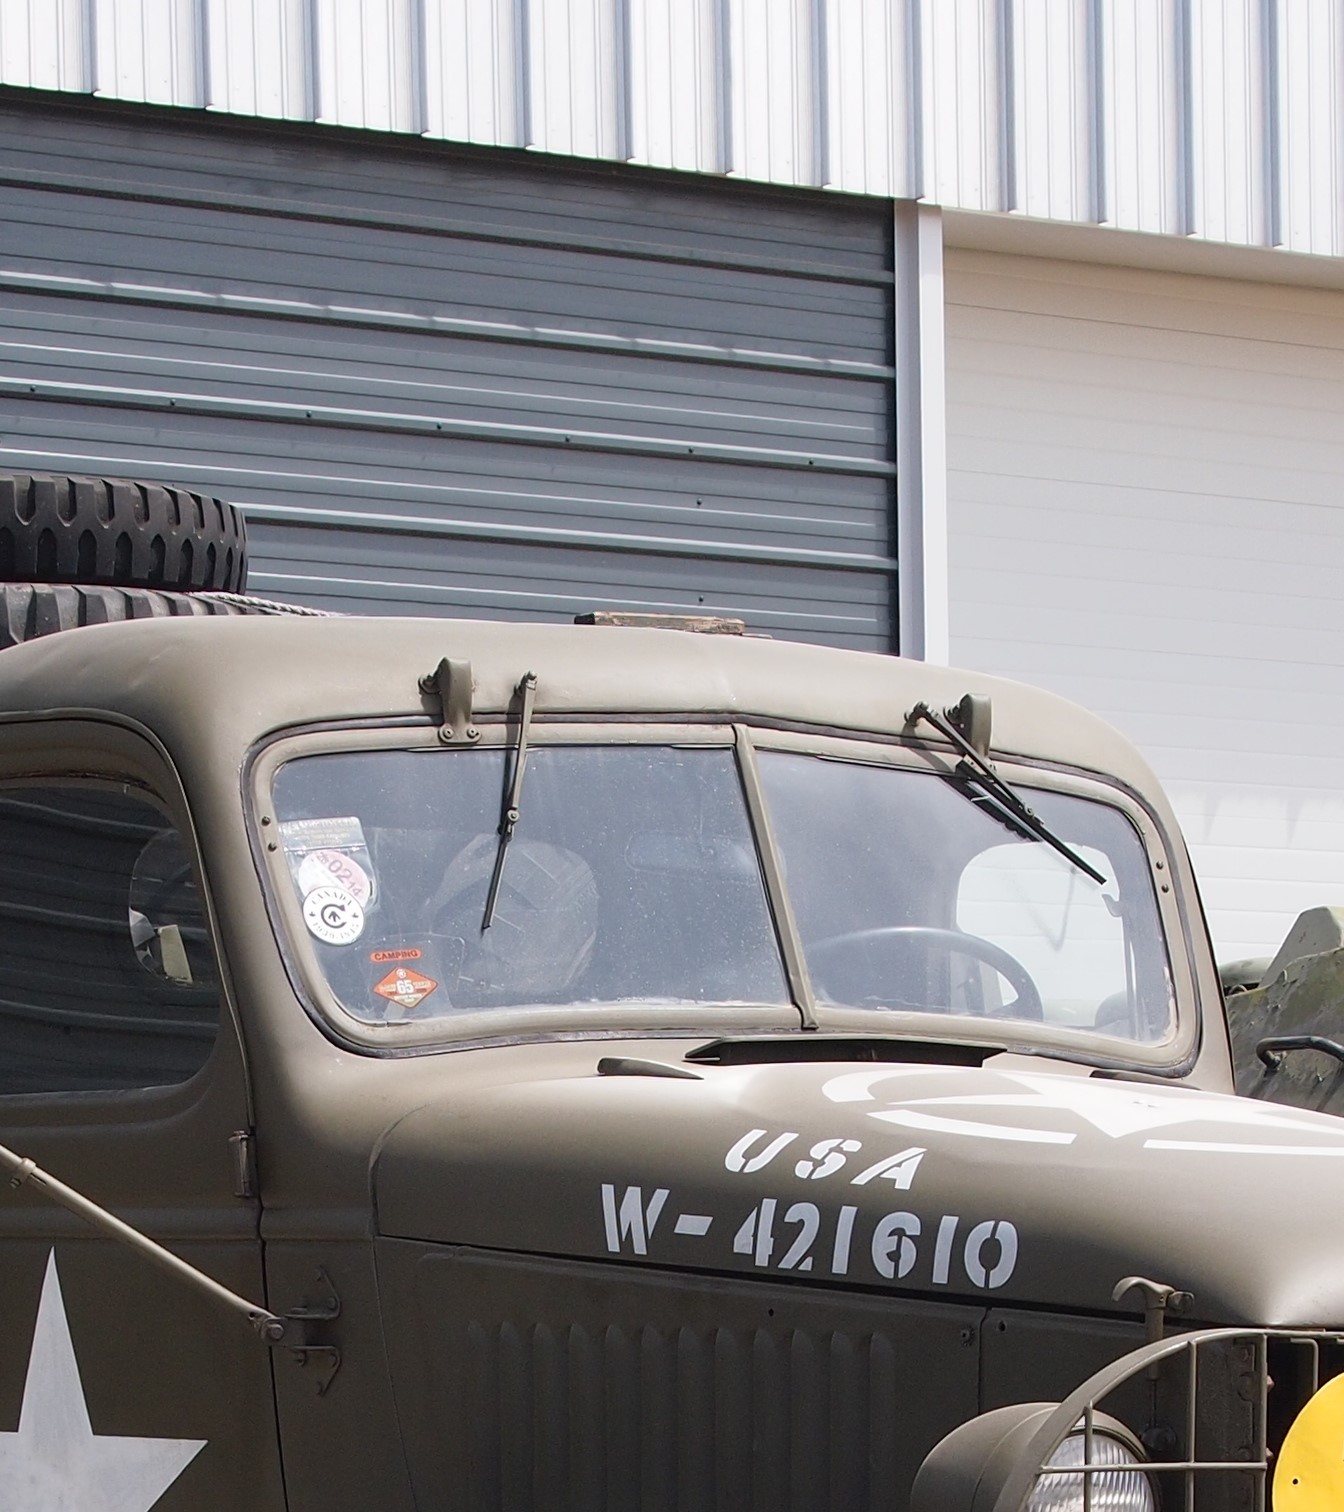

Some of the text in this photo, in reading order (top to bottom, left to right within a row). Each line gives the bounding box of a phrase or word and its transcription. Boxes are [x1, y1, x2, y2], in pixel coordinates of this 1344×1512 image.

[374, 950, 419, 961] CAMPING
[396, 980, 414, 994] 65
[724, 1128, 928, 1190] USA
[601, 1182, 1019, 1290] W-421610
